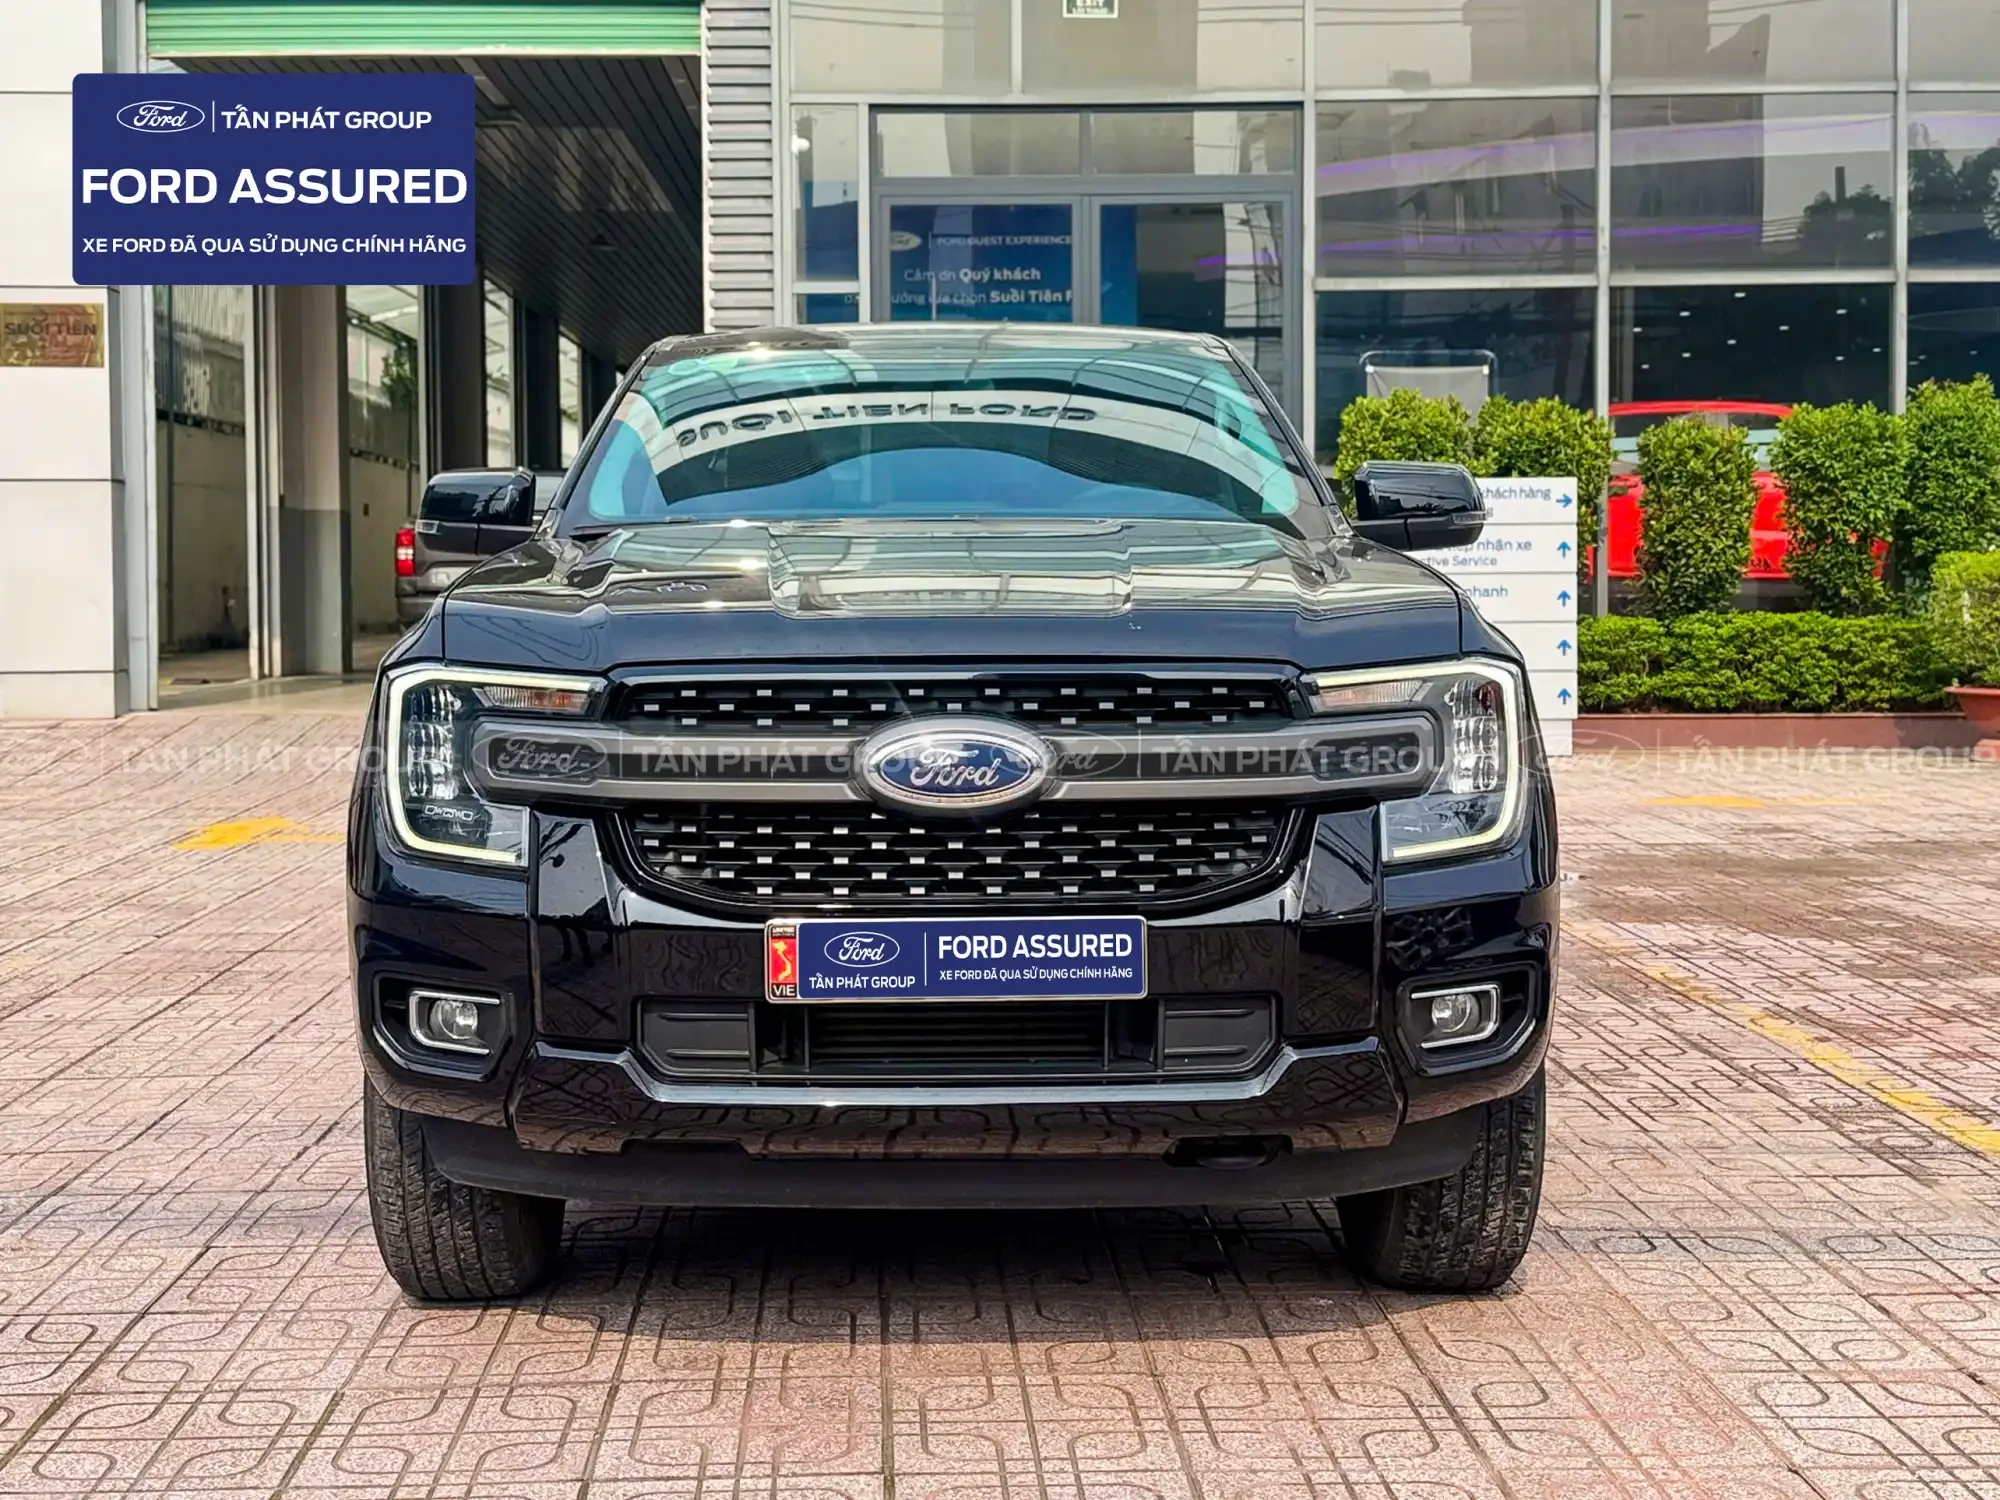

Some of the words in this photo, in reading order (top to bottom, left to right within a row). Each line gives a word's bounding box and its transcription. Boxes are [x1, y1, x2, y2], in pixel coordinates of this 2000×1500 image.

[959, 267, 990, 283] Quý
[993, 267, 1041, 281] khách
[1519, 486, 1552, 501] hàng
[1516, 541, 1532, 551] xe
[1451, 555, 1498, 567] Service
[910, 748, 1002, 787] Ford
[838, 936, 886, 961] Ford
[938, 935, 1007, 960] FORD
[1012, 932, 1133, 959] ASSURED
[836, 973, 869, 989] PHÁT
[871, 975, 916, 989] GROUP
[939, 970, 953, 981] XE
[954, 969, 982, 981] FORD
[983, 967, 998, 980] ĐÃ
[999, 969, 1021, 982] QUA
[1023, 966, 1038, 980] SỬ
[1039, 969, 1068, 982] DỤNG
[1070, 965, 1101, 979] CHÍNH
[1103, 965, 1133, 979] HÃNG
[773, 984, 796, 997] VIE
